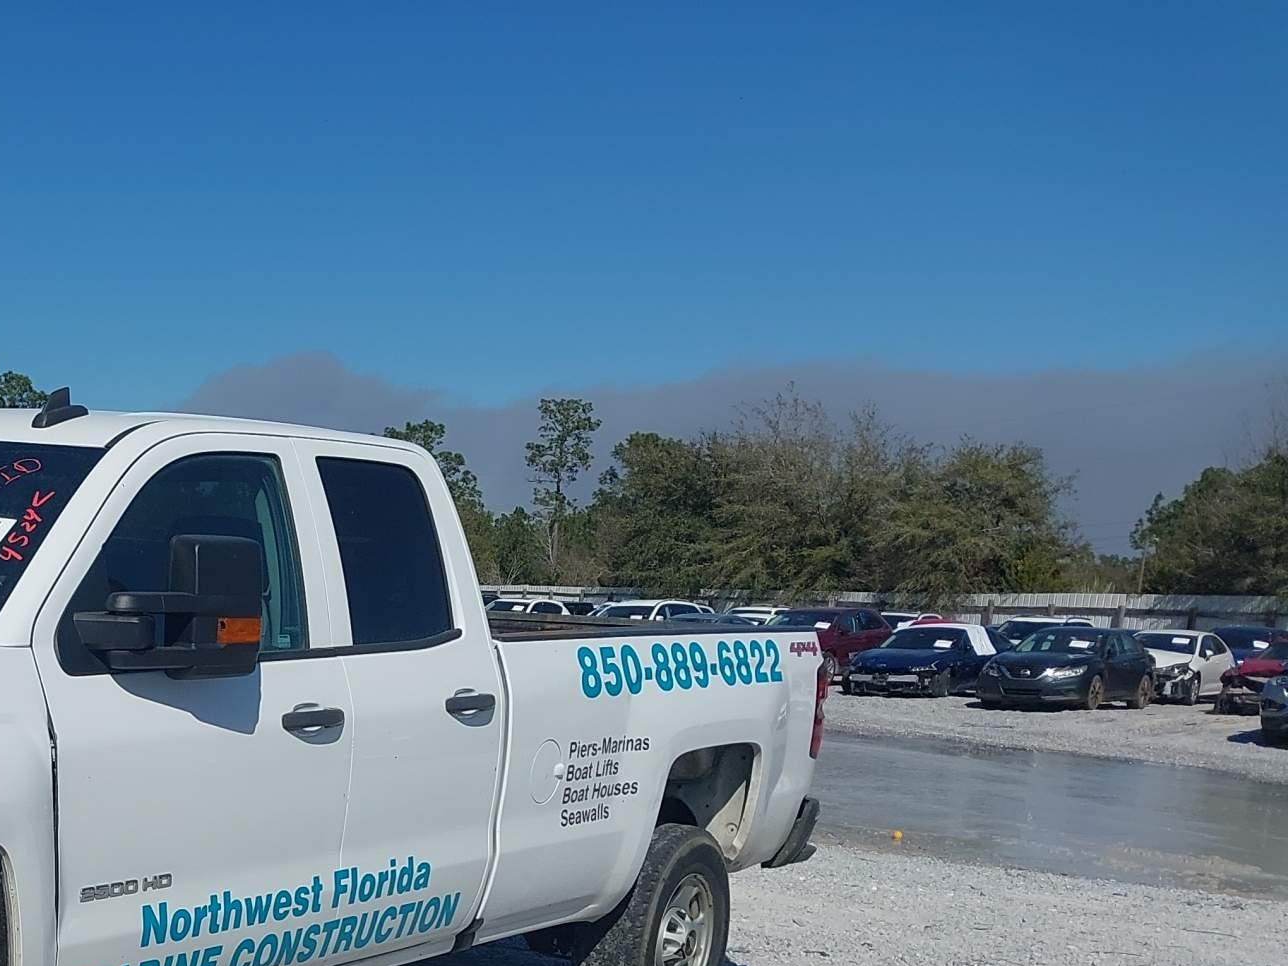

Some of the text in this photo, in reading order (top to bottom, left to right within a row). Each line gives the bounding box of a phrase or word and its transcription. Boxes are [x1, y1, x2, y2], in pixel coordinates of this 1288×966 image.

[577, 639, 783, 699] 850-889-6822
[569, 736, 650, 759] Piers-Marinas
[566, 759, 619, 782] Boat Lifts
[562, 782, 639, 804] Boat Houses
[560, 803, 610, 827] Seawalls
[79, 873, 173, 903] 2500 HD
[140, 856, 431, 948] Northwest Florida
